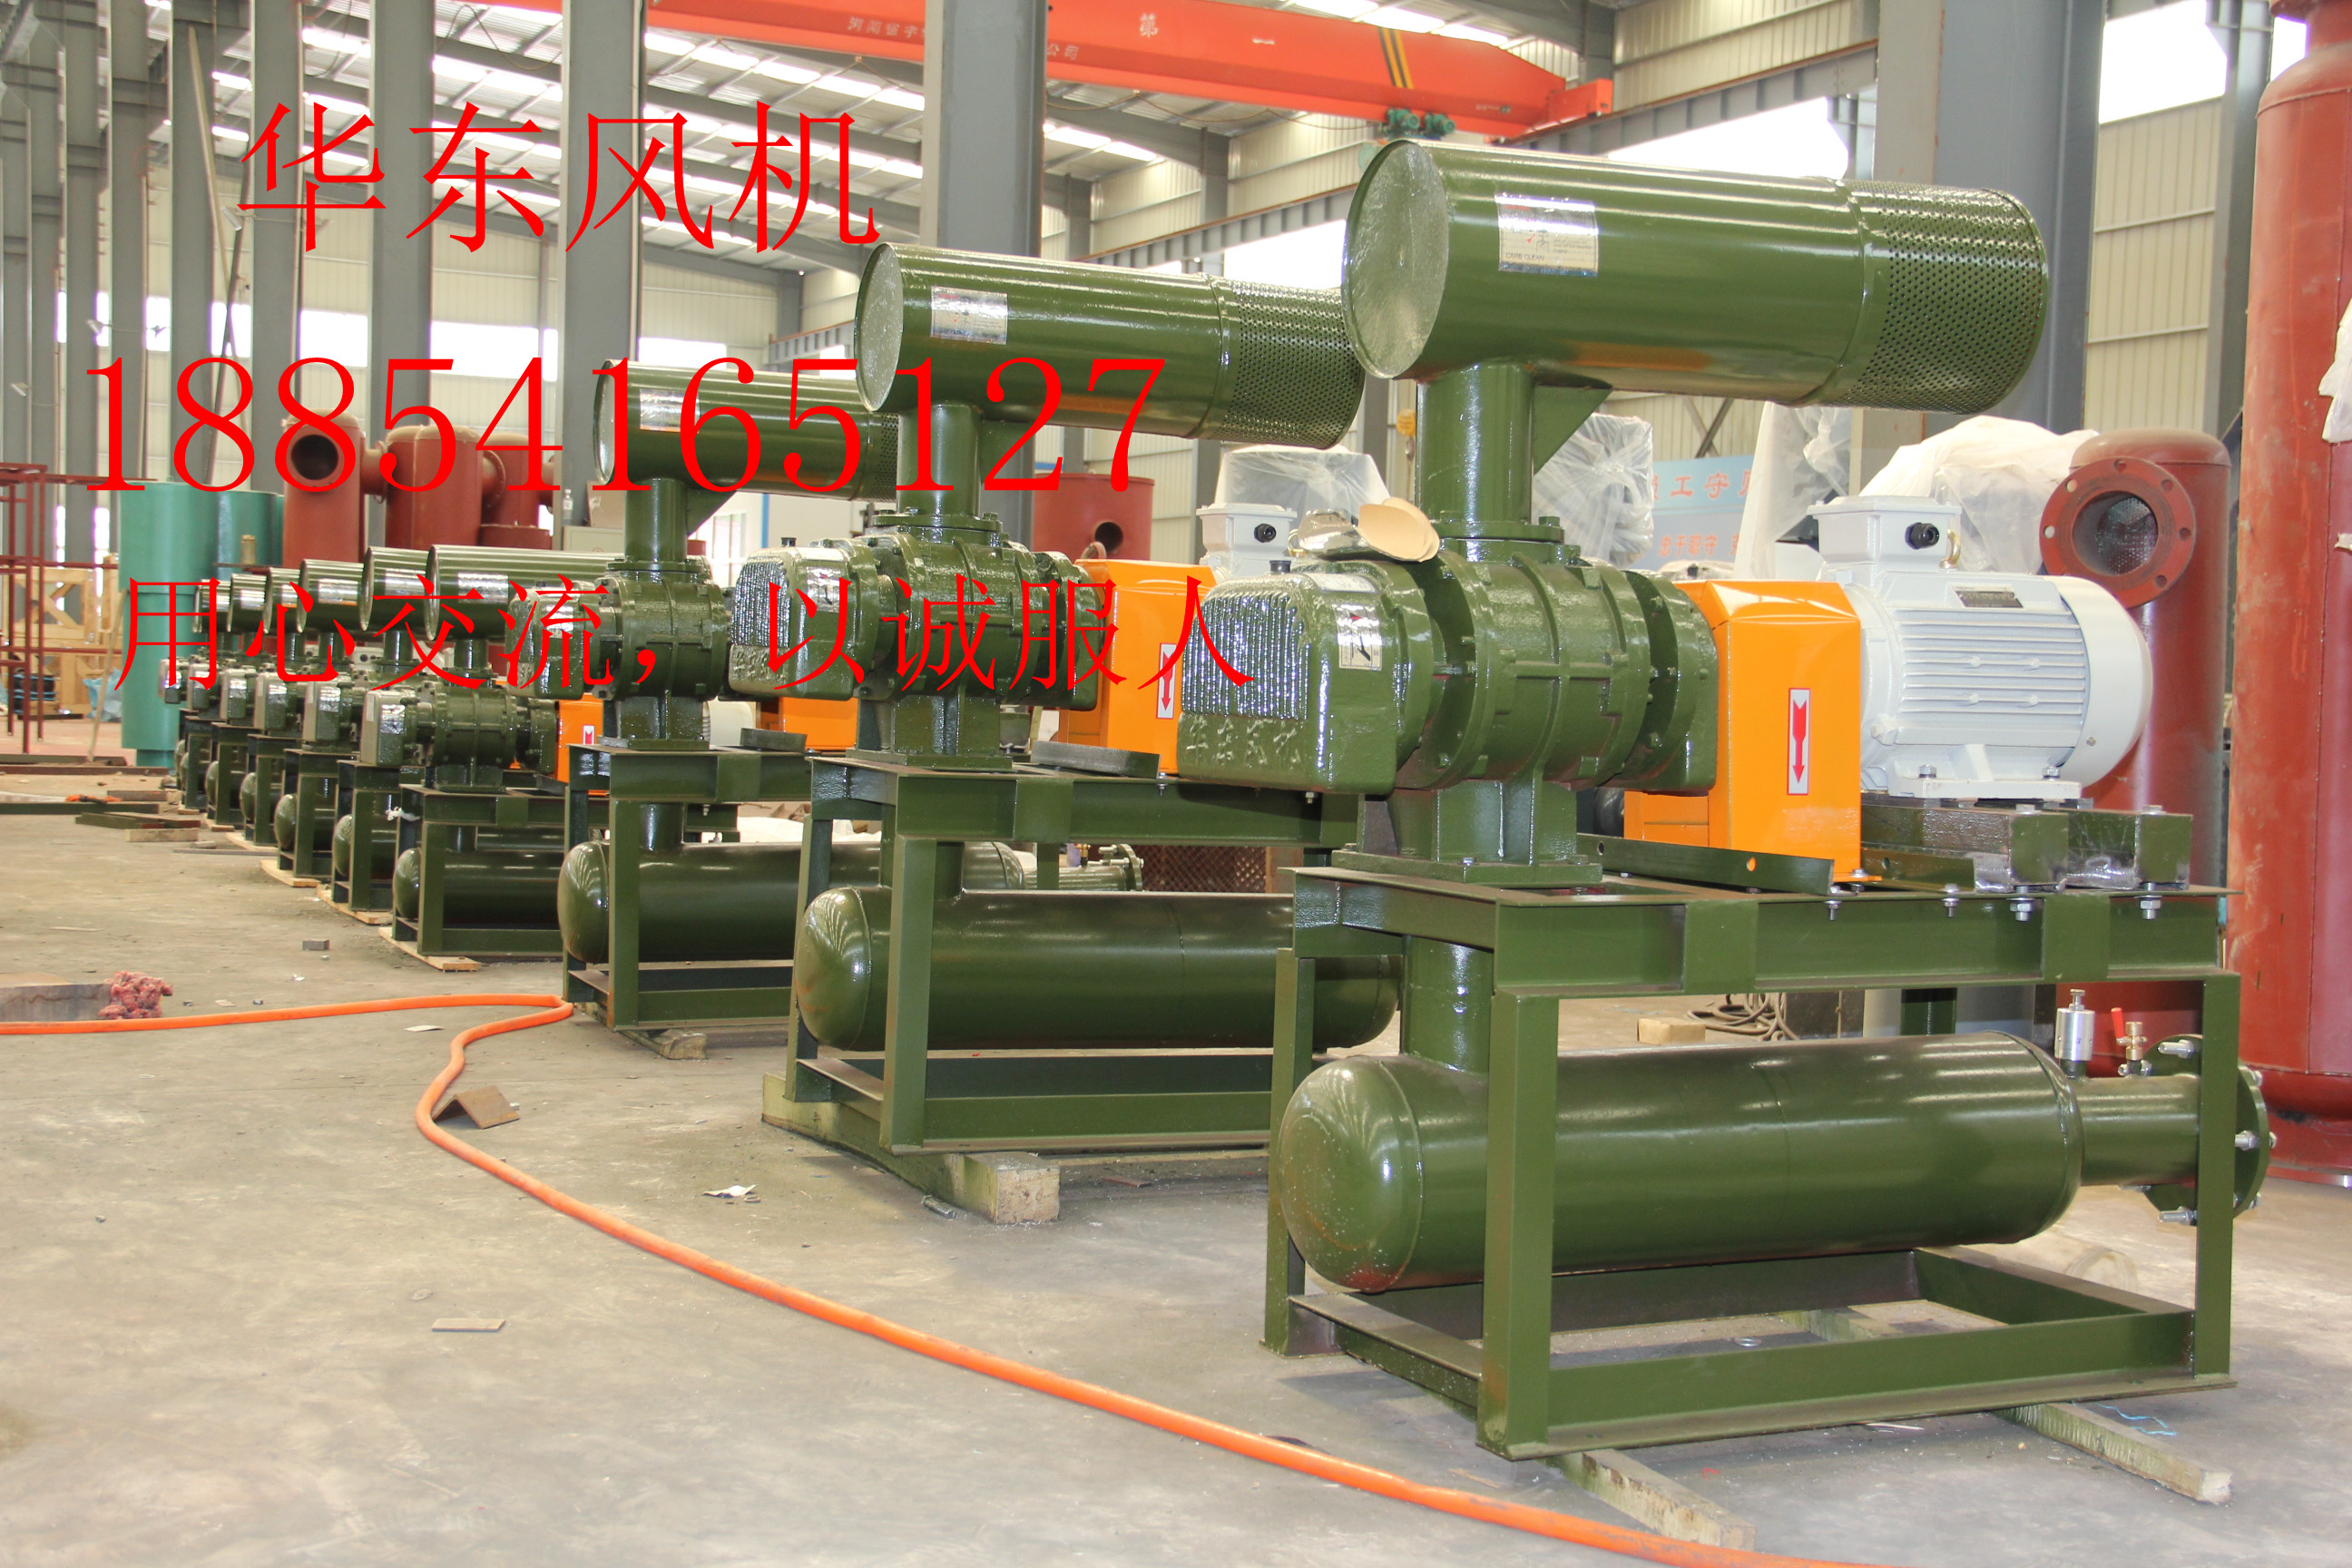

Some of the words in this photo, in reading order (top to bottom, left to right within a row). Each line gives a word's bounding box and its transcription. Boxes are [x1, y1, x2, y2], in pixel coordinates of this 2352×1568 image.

[1046, 43, 1080, 60] 公司
[1659, 534, 1718, 557] 忠于职守
